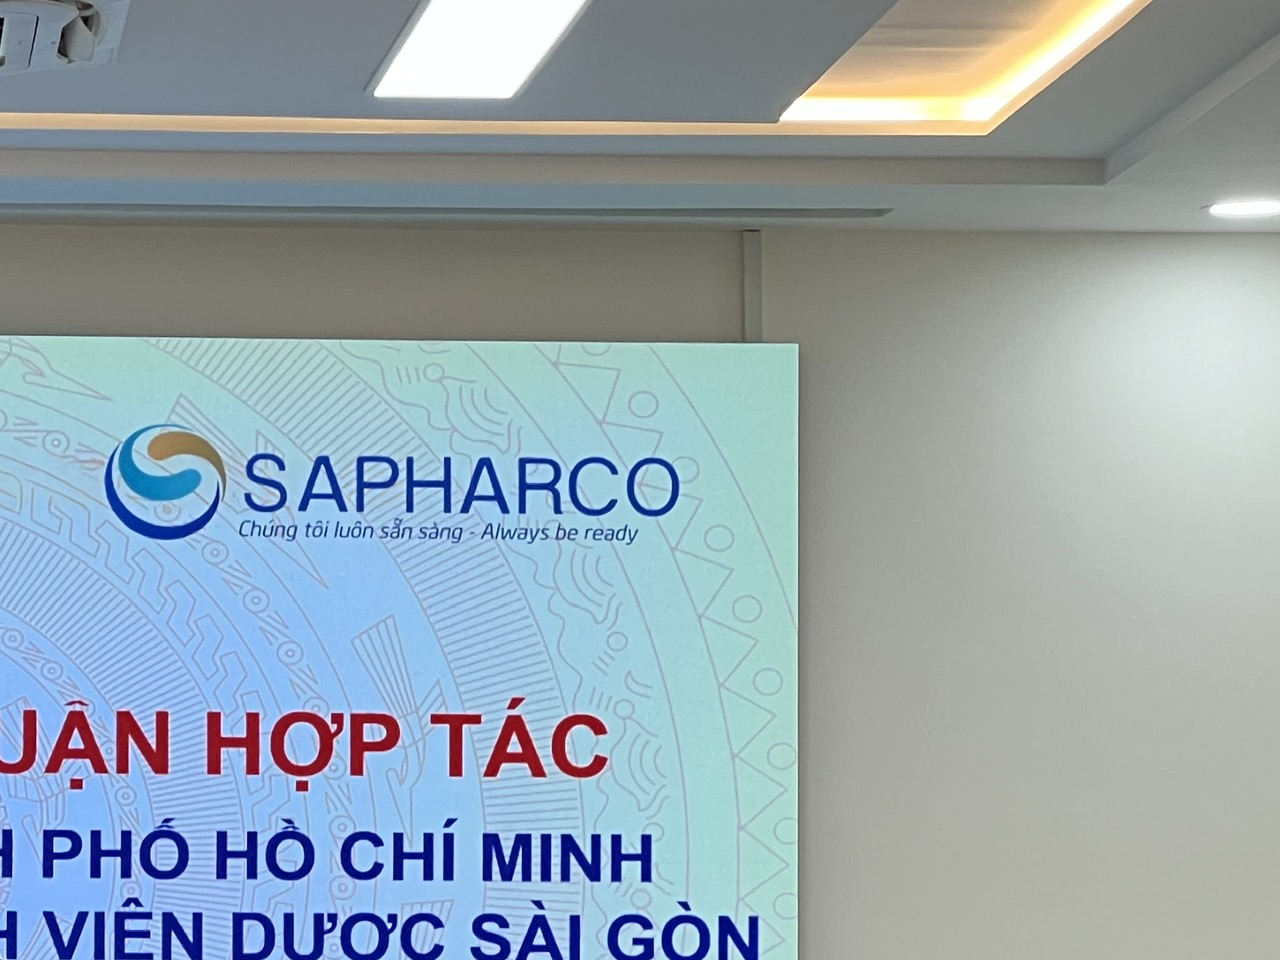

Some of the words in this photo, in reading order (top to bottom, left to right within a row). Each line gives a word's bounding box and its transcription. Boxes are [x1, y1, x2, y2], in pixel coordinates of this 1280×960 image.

[244, 453, 680, 517] SAPHARCO
[238, 520, 298, 541] Chúng
[305, 520, 329, 538] tôi
[334, 520, 374, 538] luôn
[379, 517, 413, 540] sẵn
[418, 521, 463, 544] sàng
[481, 523, 550, 544] Always
[555, 523, 579, 541] be
[584, 524, 639, 545] ready
[207, 711, 401, 792] HỢP
[431, 697, 608, 778] TÁC
[42, 817, 190, 880] PHỐ
[216, 818, 315, 881] HỒ
[340, 818, 458, 881] CHÍ
[482, 833, 652, 883] MINH
[42, 897, 203, 960] VIÊN
